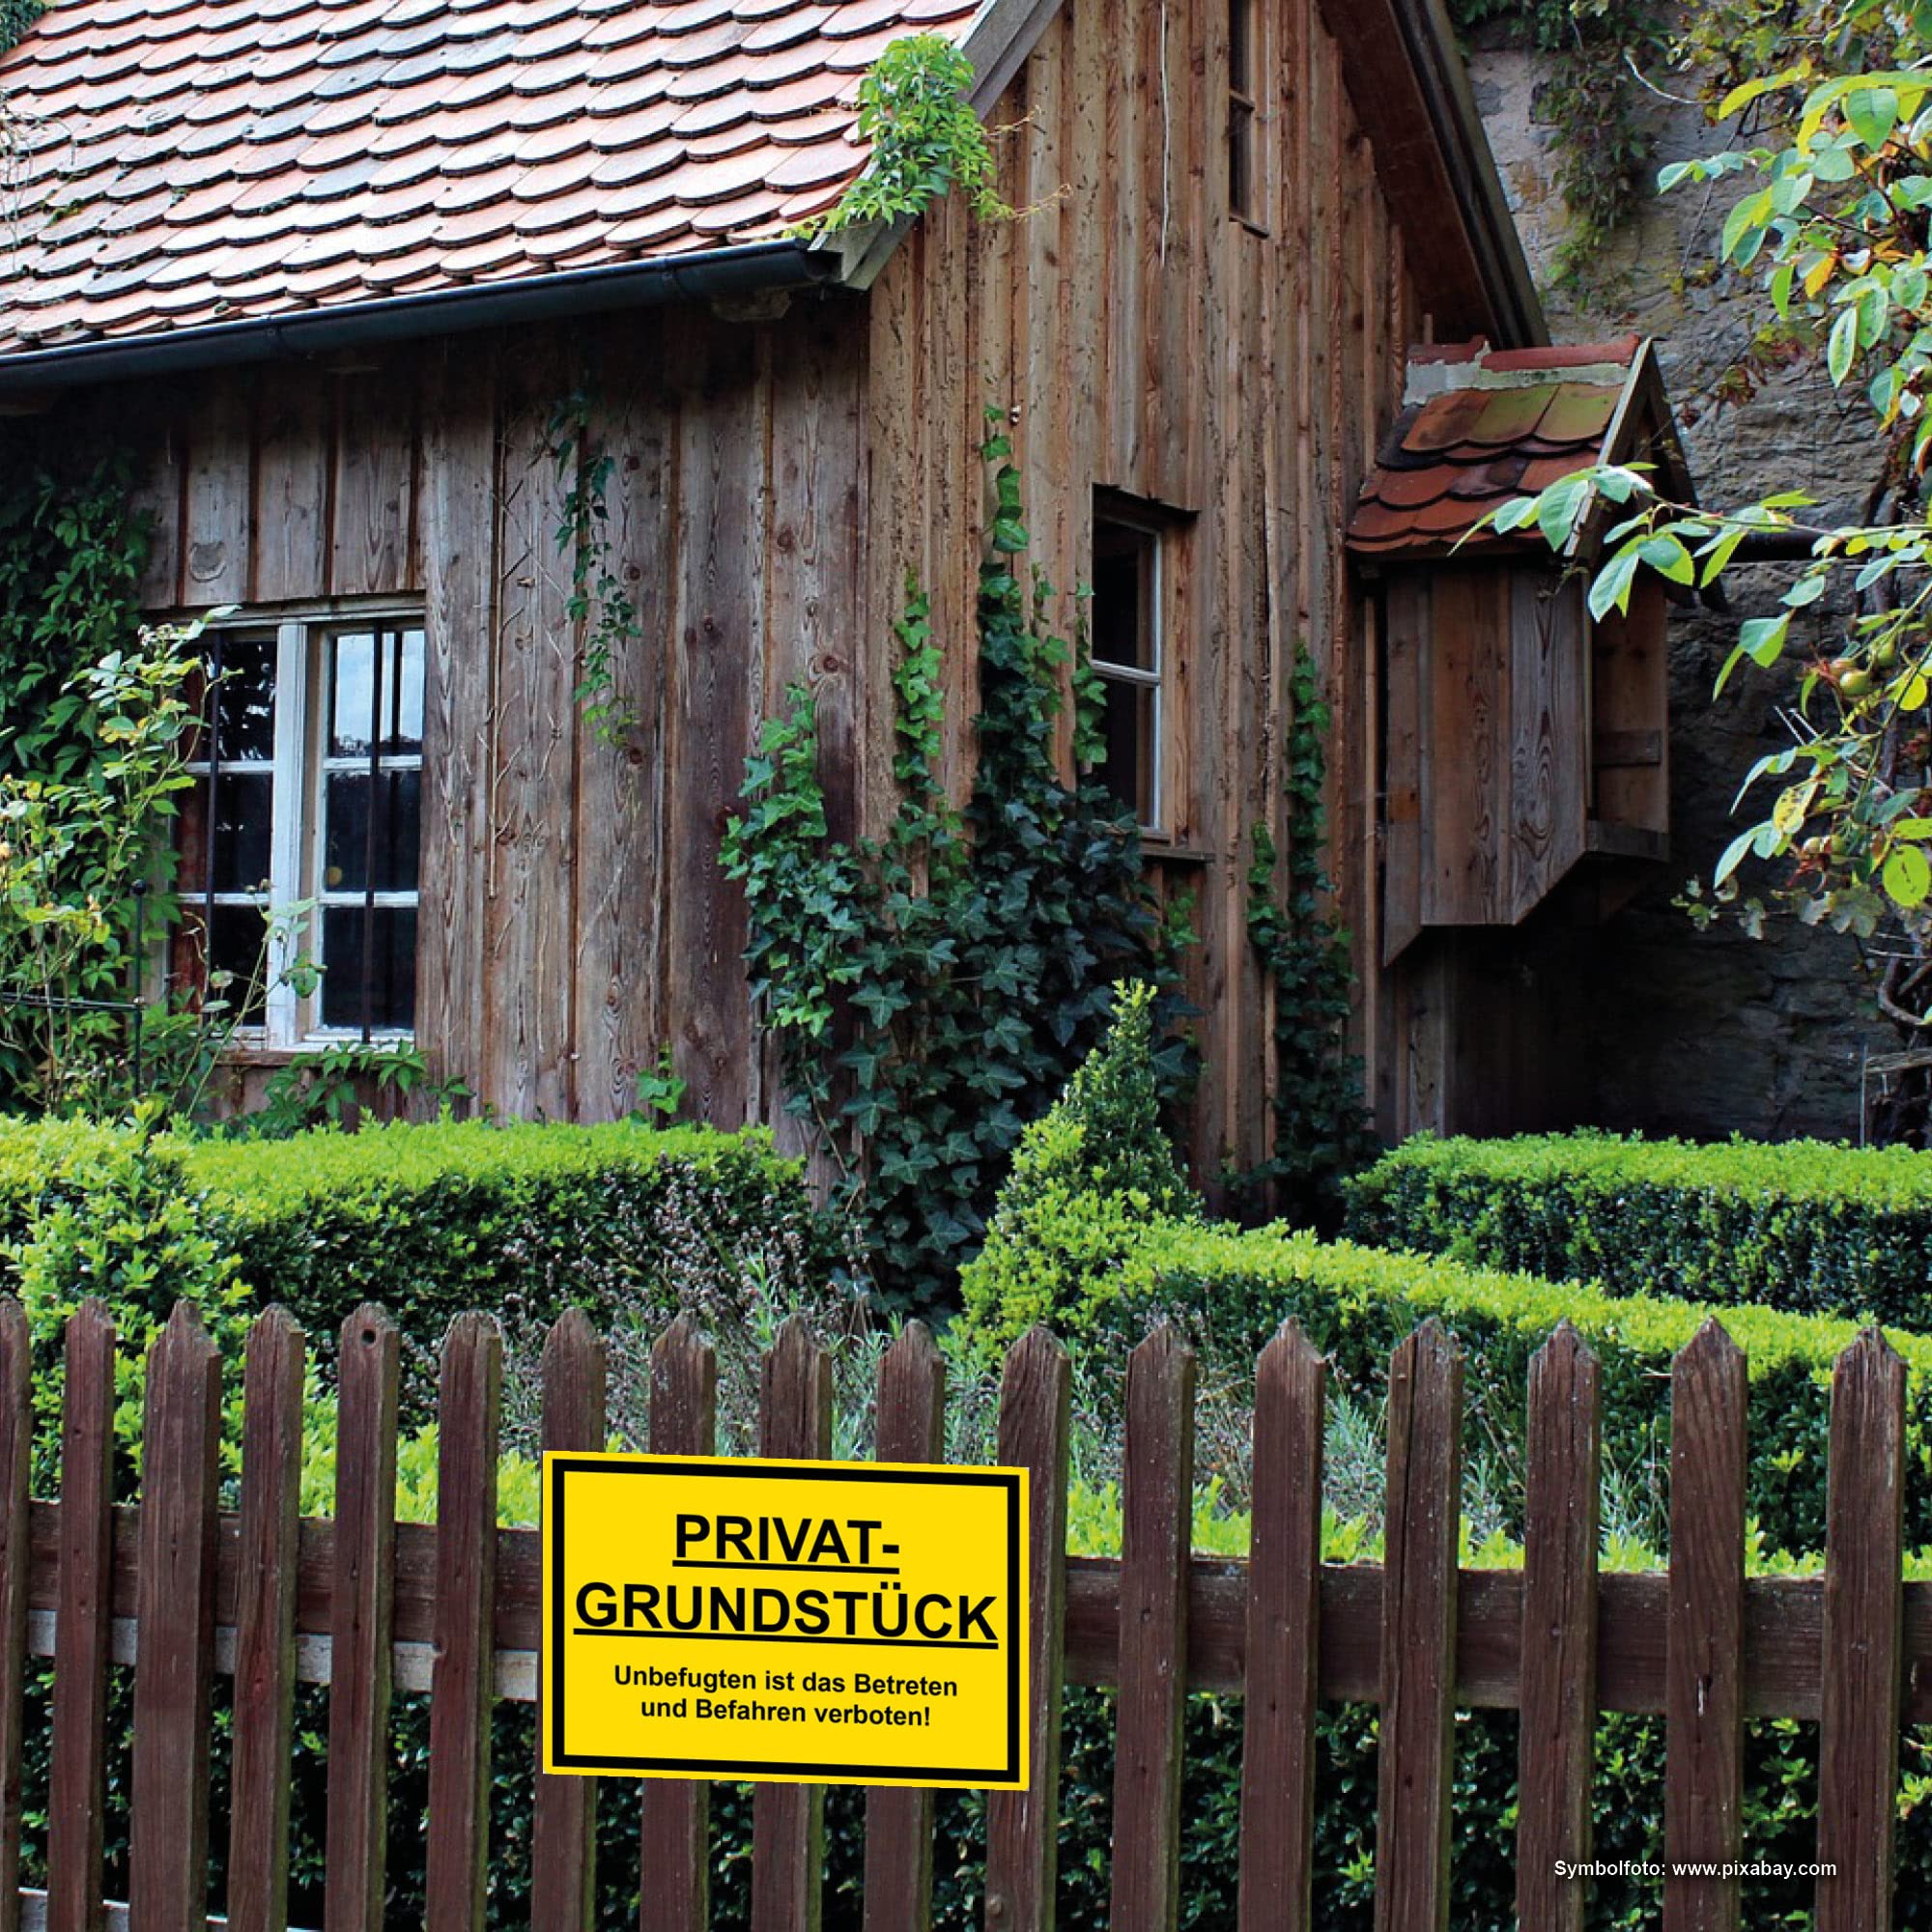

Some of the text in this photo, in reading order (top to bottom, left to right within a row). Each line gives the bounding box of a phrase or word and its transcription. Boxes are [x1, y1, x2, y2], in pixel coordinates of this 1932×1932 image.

[676, 1514, 899, 1565] PRIVAT-
[576, 1581, 998, 1640] GRUNDSTÜCK
[614, 1664, 957, 1696] Unbefugten ist das Betreten
[641, 1697, 930, 1726] und Befahren verboten!
